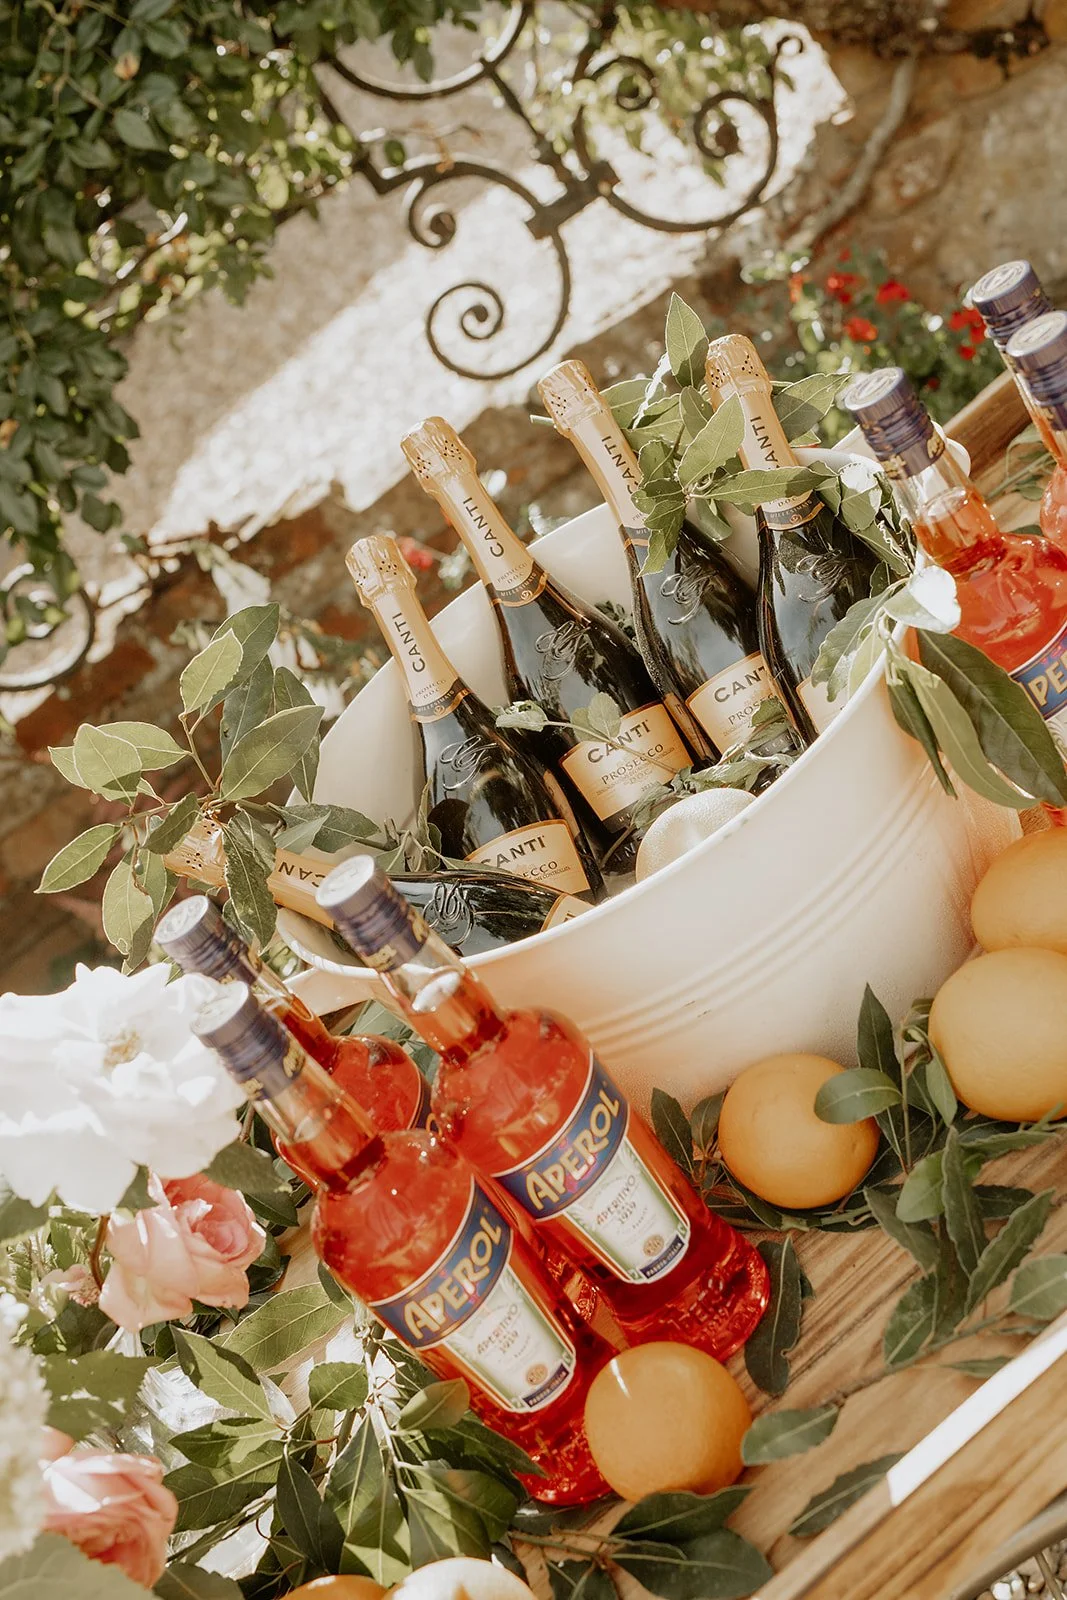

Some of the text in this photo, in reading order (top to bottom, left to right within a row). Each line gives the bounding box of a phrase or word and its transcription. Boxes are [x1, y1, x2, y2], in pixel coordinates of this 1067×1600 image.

[750, 415, 779, 468] ANTI
[463, 497, 505, 557] CANTI
[392, 612, 426, 673] CANTI
[728, 692, 778, 725] PROS
[587, 720, 651, 764] CANTI
[601, 743, 664, 785] PROSECCO
[525, 1089, 620, 1211] APEROL
[403, 1216, 502, 1340] APEROL
